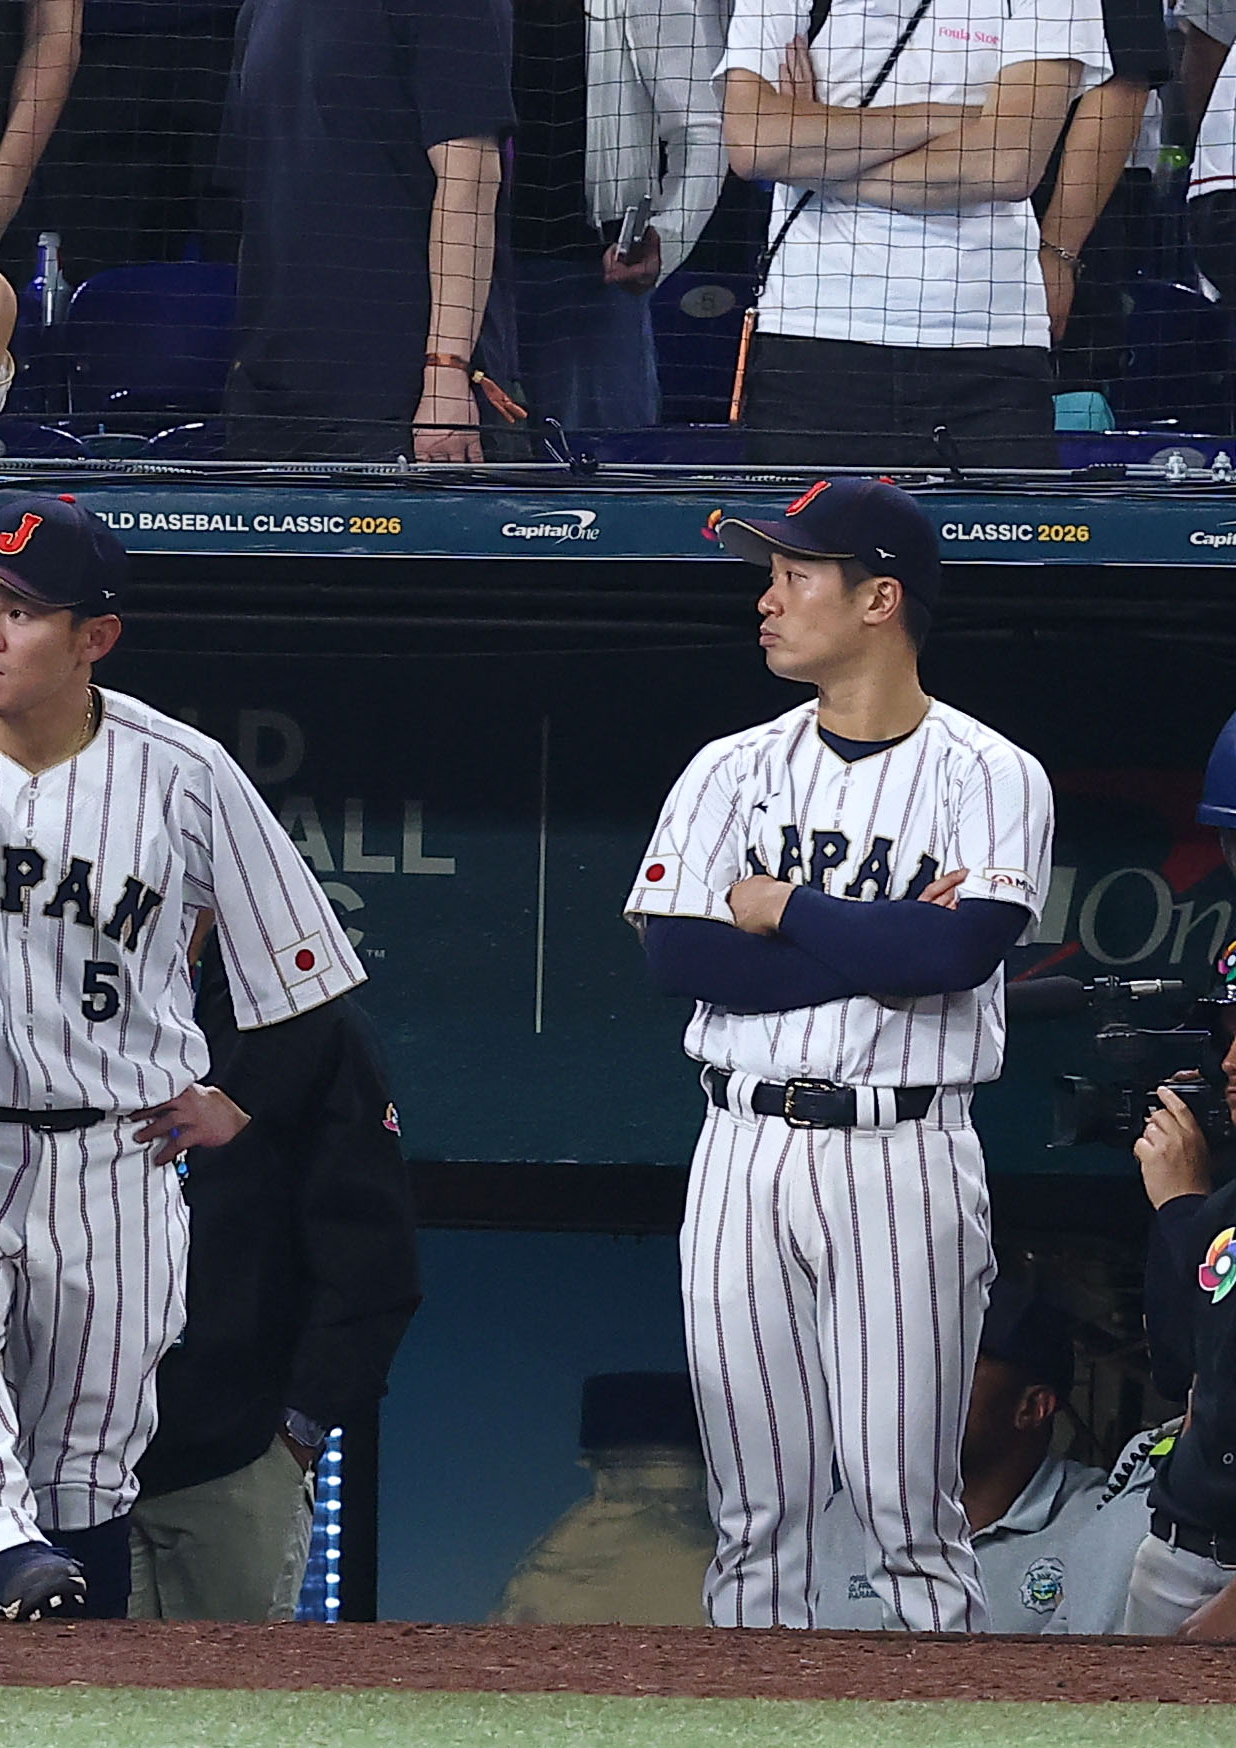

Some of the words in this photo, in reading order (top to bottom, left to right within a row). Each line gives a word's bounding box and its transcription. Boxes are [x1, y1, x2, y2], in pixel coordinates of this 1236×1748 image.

[139, 514, 250, 532] BASEBALL
[253, 516, 344, 533] CLASSIC
[349, 518, 402, 534] 2026
[942, 523, 1033, 541] CLASSIC
[1037, 525, 1090, 542] 2026
[81, 959, 120, 1023] 5
